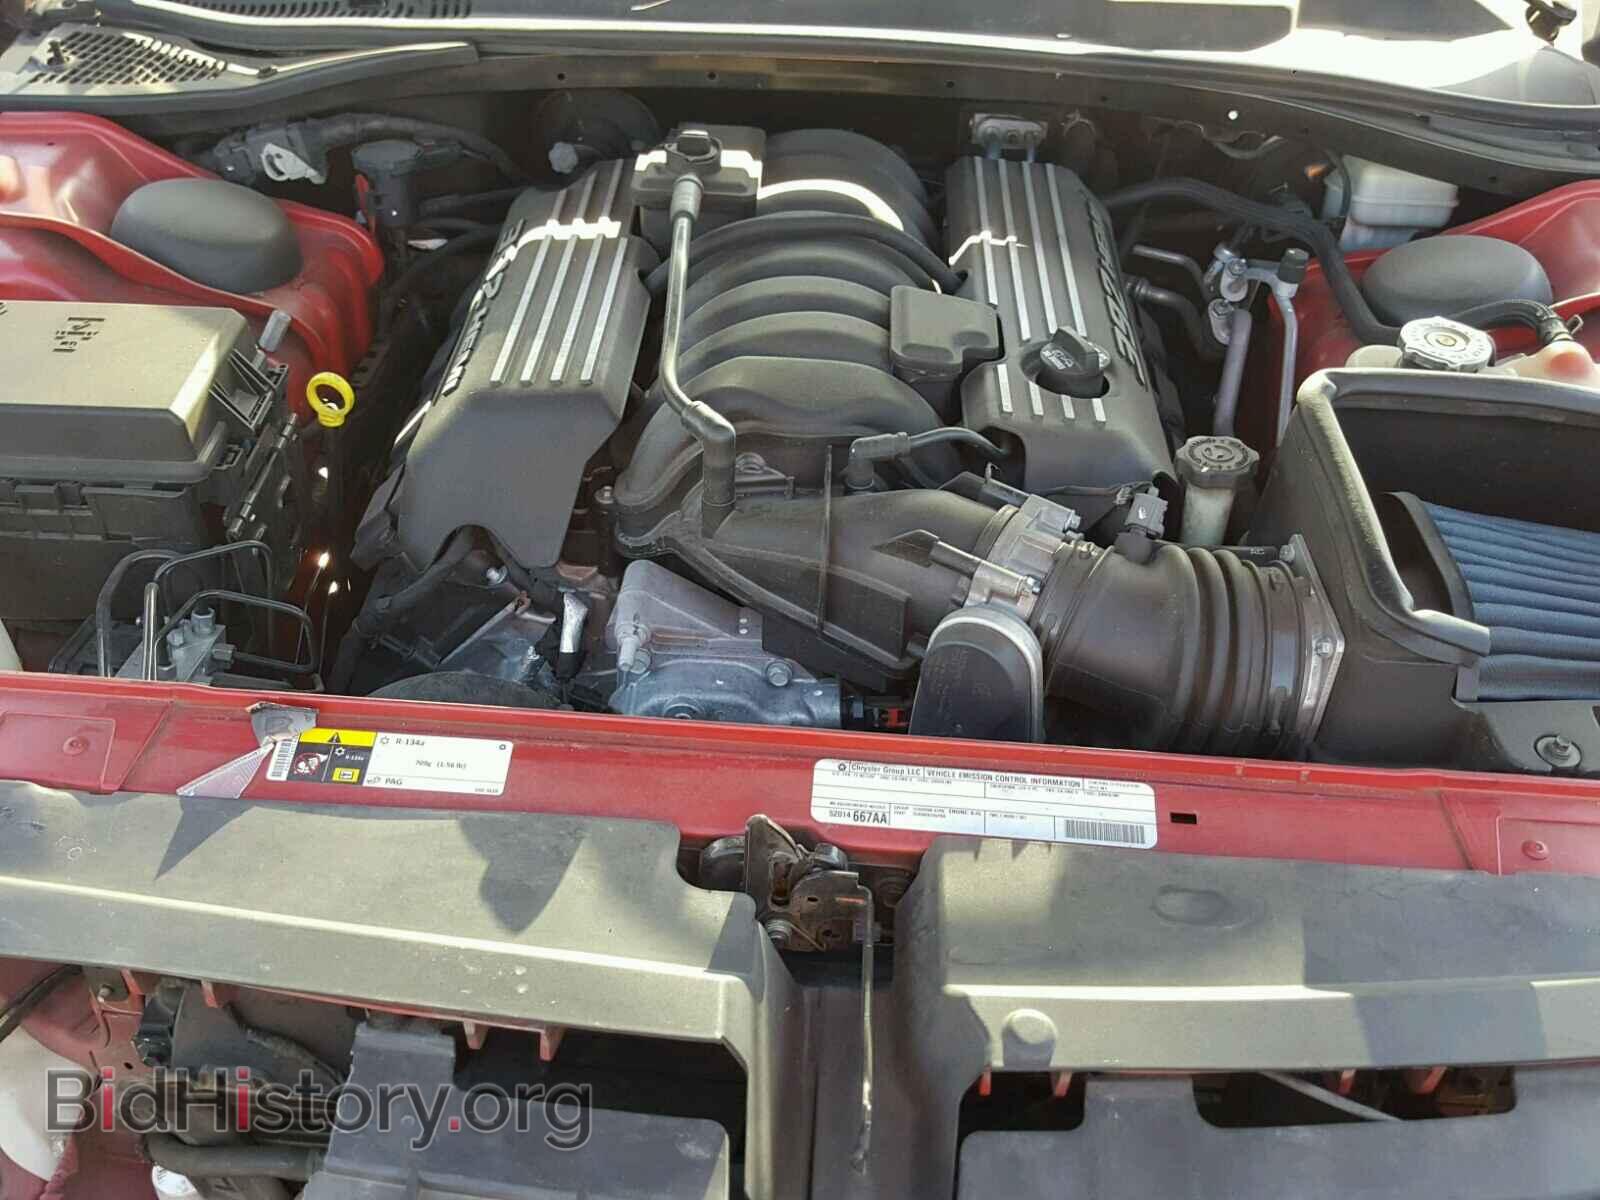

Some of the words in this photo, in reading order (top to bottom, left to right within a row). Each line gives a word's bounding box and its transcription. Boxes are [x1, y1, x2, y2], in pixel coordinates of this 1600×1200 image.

[395, 737, 425, 746] R-134a
[851, 764, 880, 774] Chrysler
[883, 766, 905, 777] Group
[907, 768, 921, 776] LLC
[927, 768, 956, 778] VEHICLE
[958, 771, 993, 781] EMISSION
[995, 774, 1027, 784] CONTROL
[1030, 777, 1081, 788] INFORMATION
[853, 811, 887, 824] 667AA
